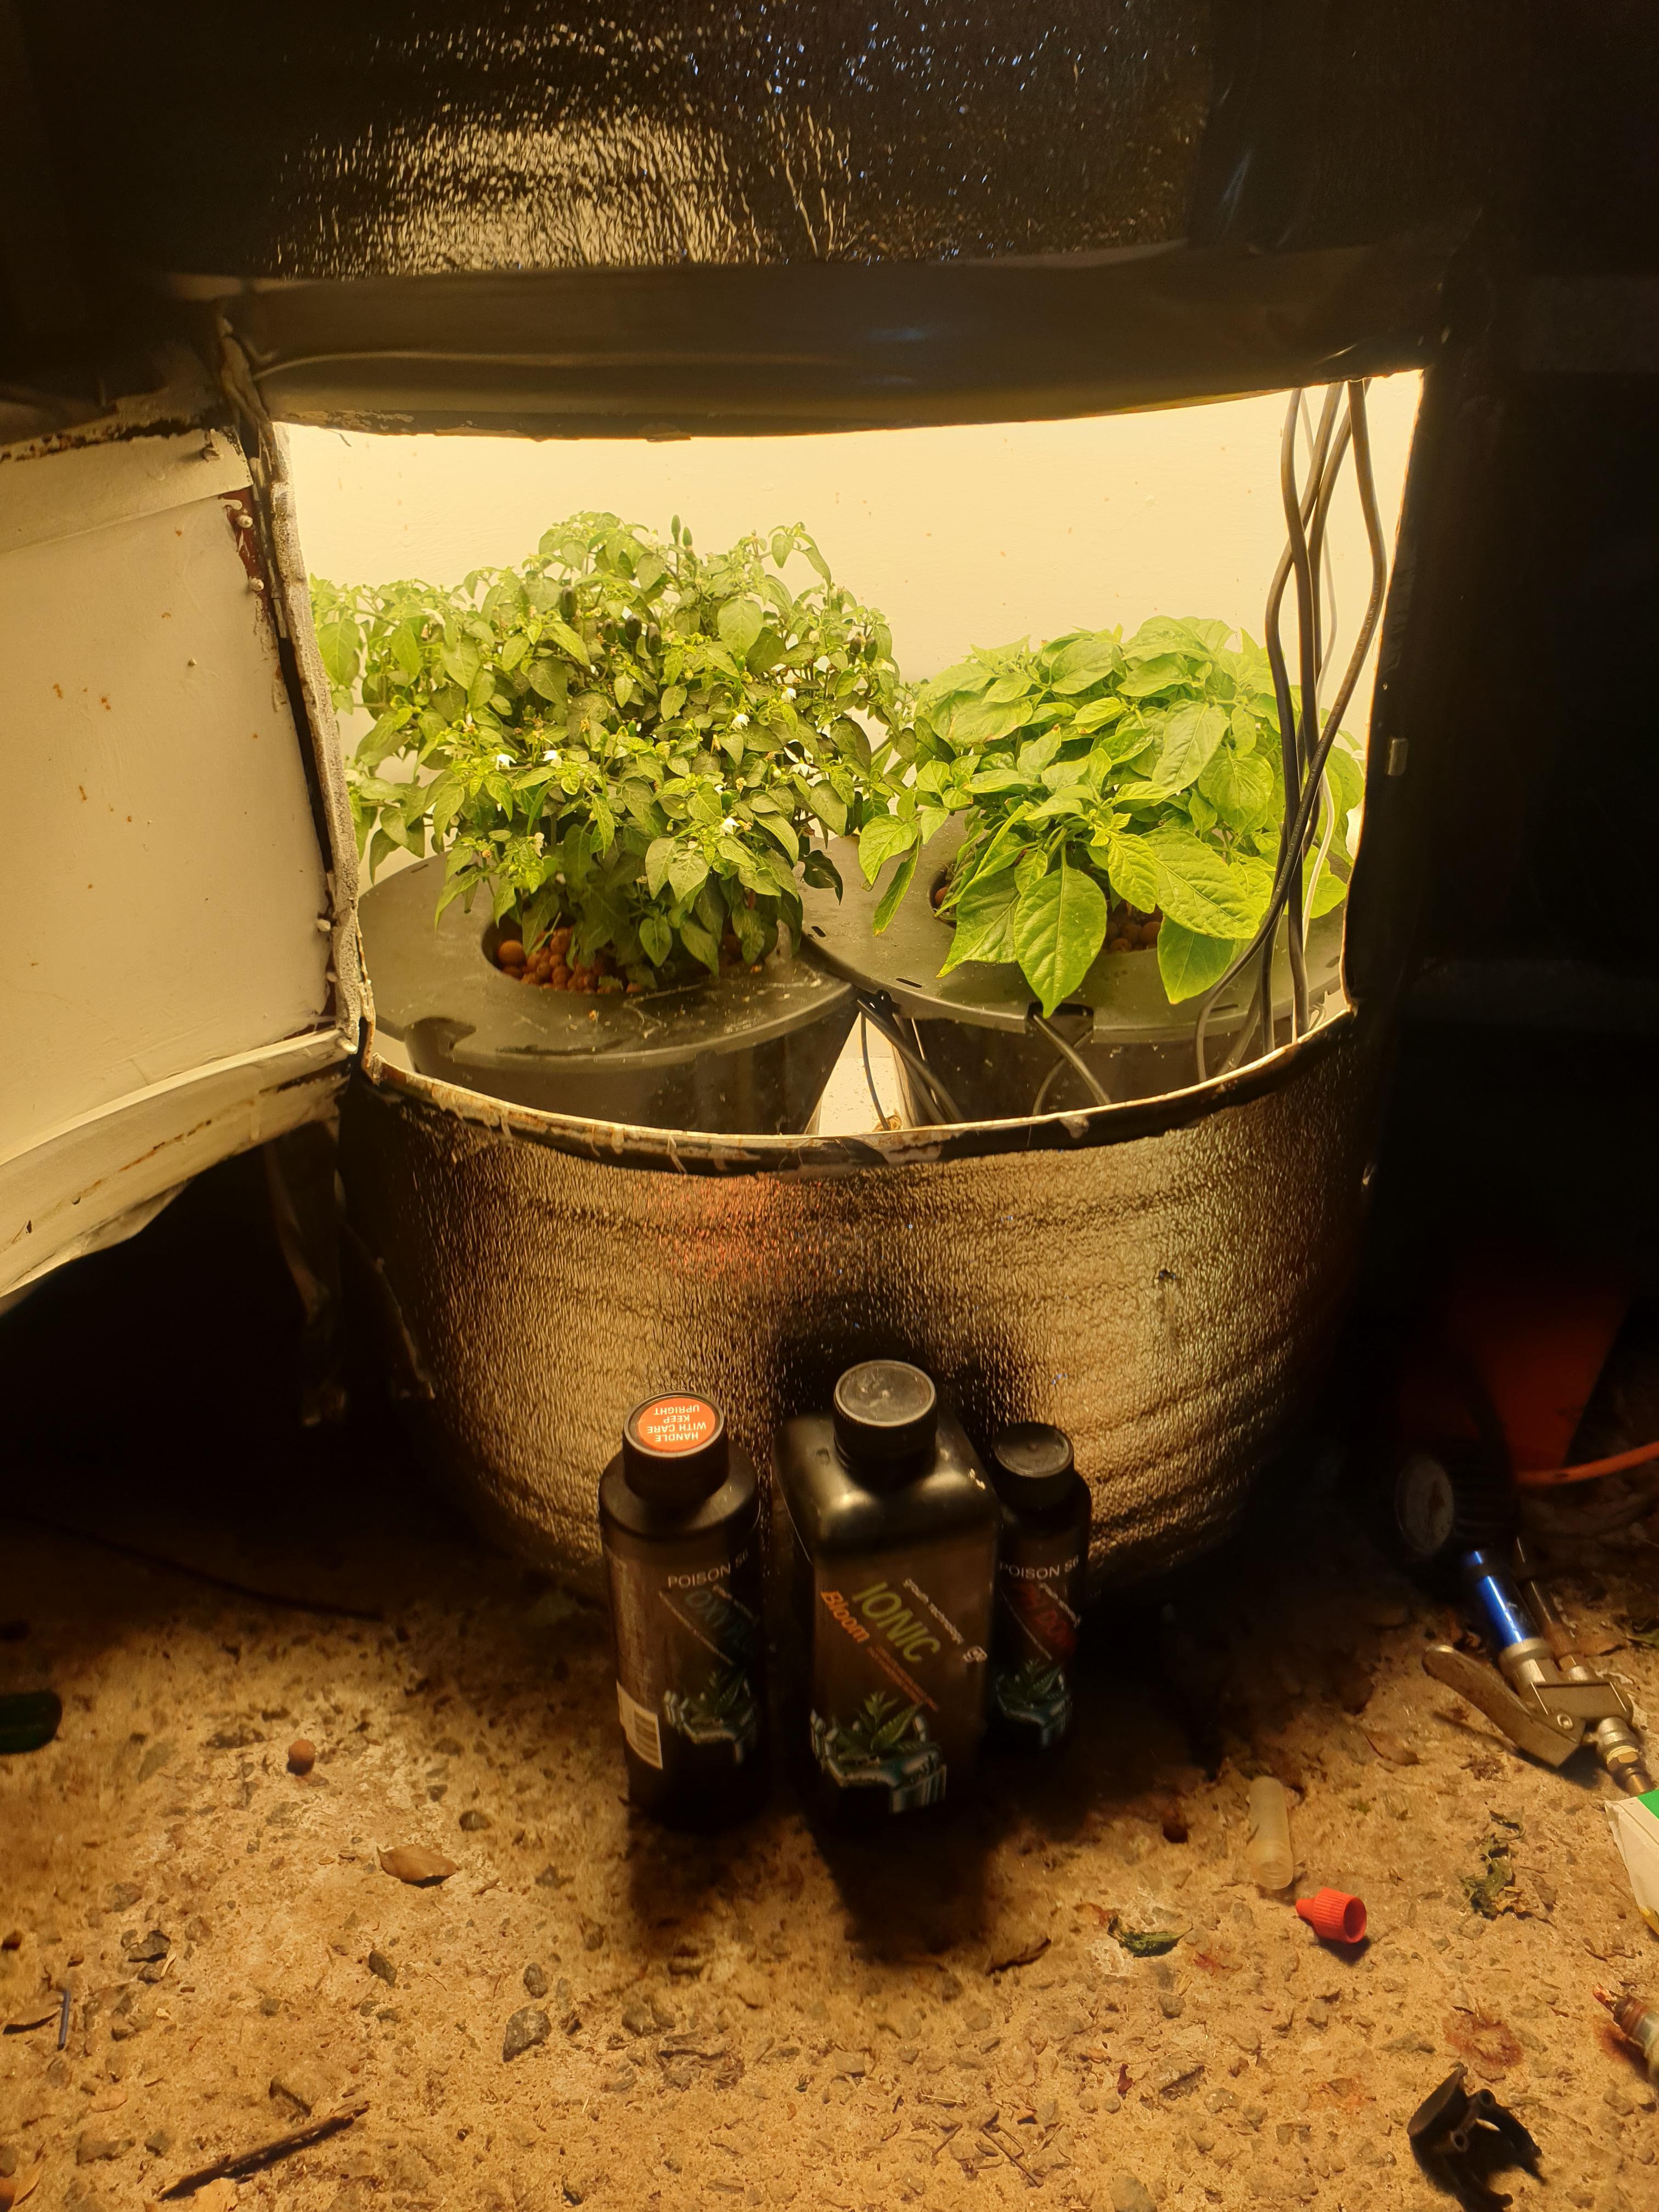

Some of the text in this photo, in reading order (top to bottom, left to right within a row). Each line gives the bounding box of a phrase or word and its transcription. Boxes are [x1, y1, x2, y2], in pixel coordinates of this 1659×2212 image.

[653, 1404, 700, 1415] UPRIGHT
[663, 1414, 690, 1424] KEEP
[647, 1422, 707, 1434] WITH CARE
[655, 1432, 698, 1442] HANDLE
[668, 1562, 731, 1588] POISON
[999, 1561, 1060, 1580] POISON
[820, 1590, 870, 1644] Bloom
[851, 1581, 941, 1663] IONIC
